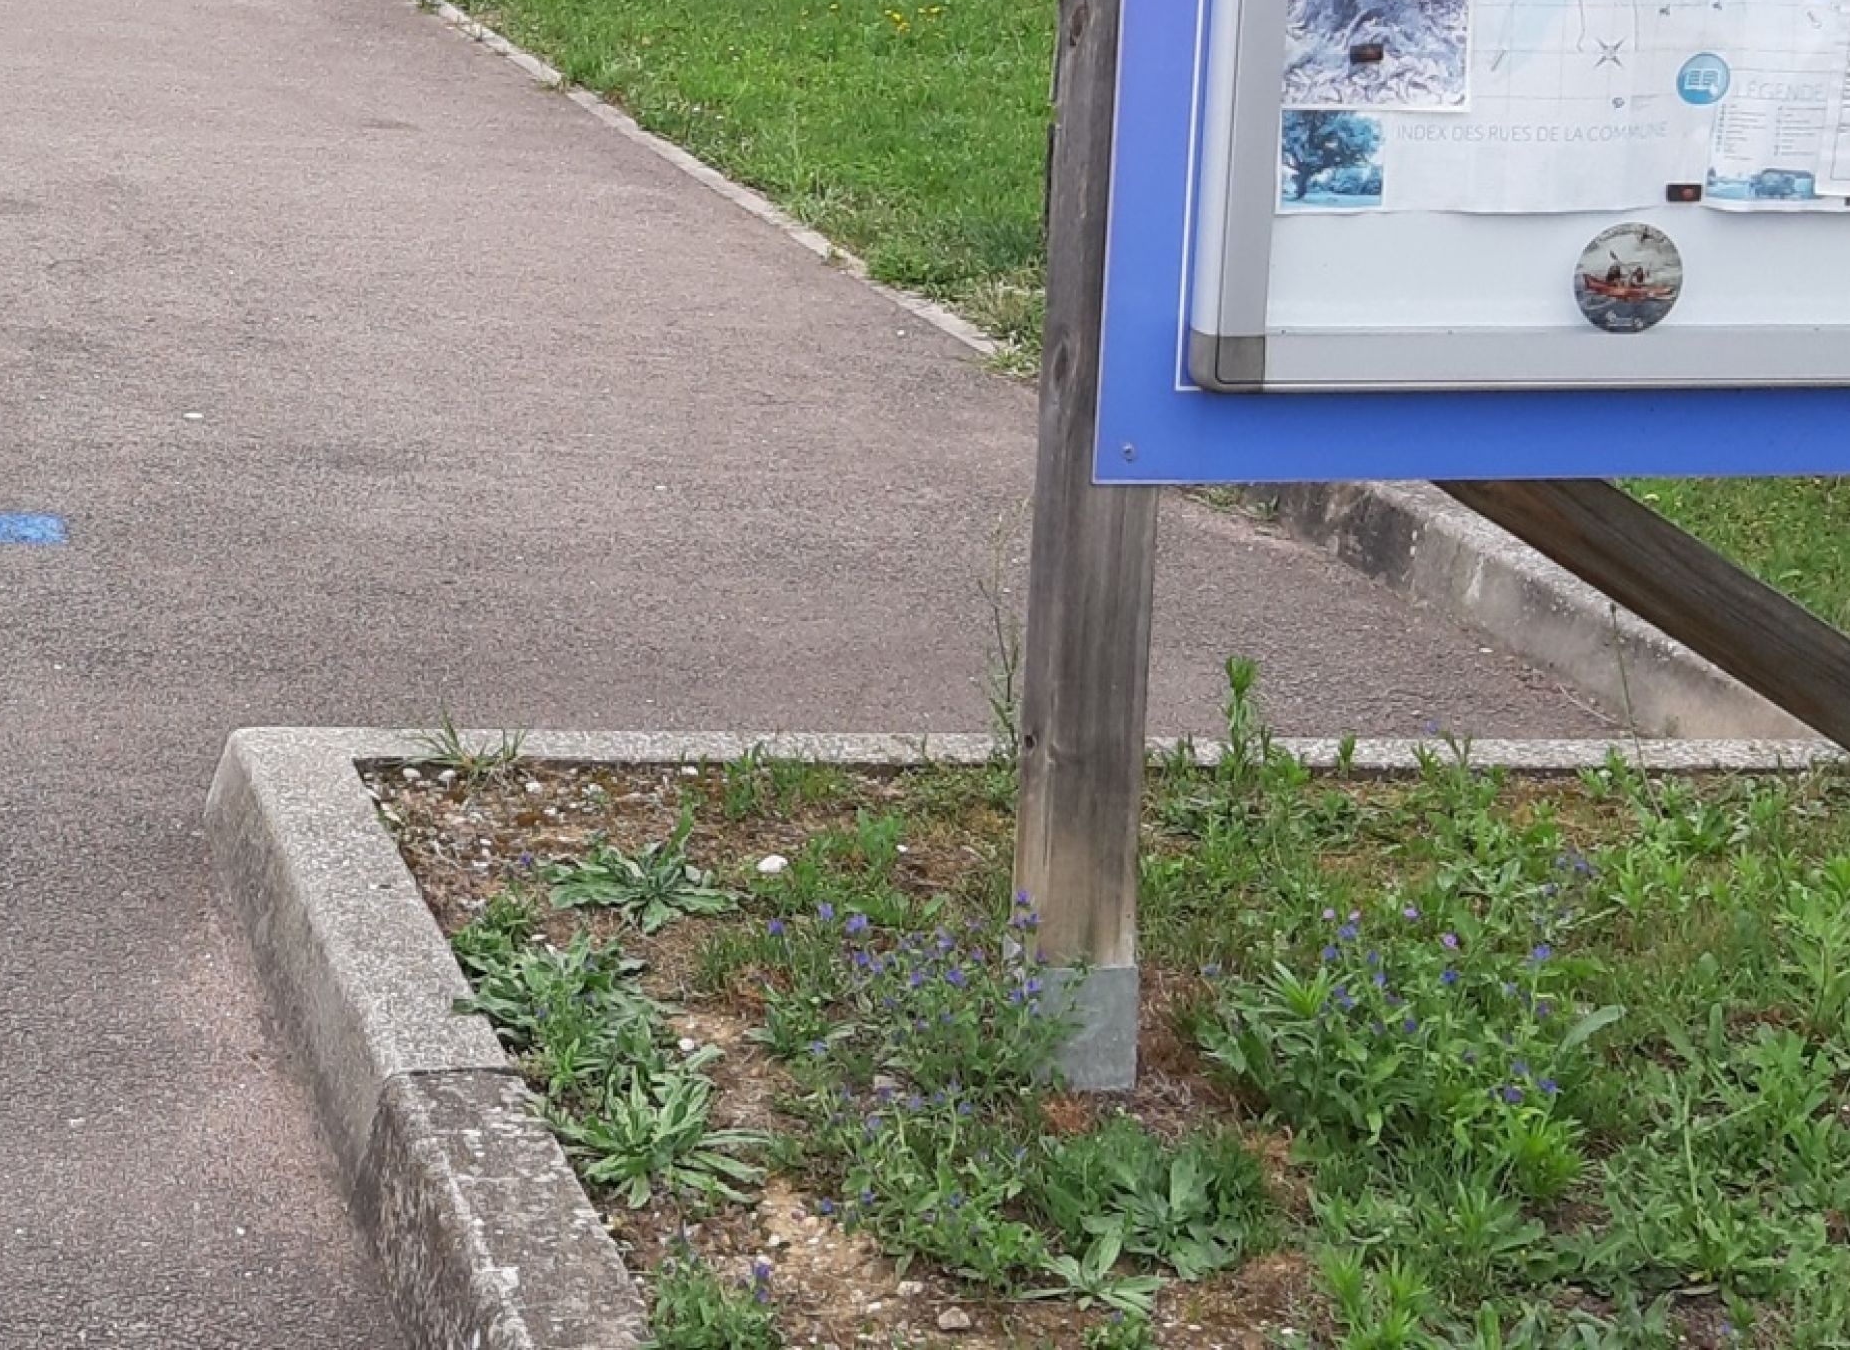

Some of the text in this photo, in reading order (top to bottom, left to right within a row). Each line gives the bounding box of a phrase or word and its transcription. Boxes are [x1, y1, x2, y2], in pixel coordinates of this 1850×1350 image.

[1397, 123, 1447, 141] INDEX
[1451, 124, 1484, 142] DES
[1489, 125, 1532, 143] RUES
[1536, 125, 1560, 143] DE
[1564, 125, 1584, 142] LA
